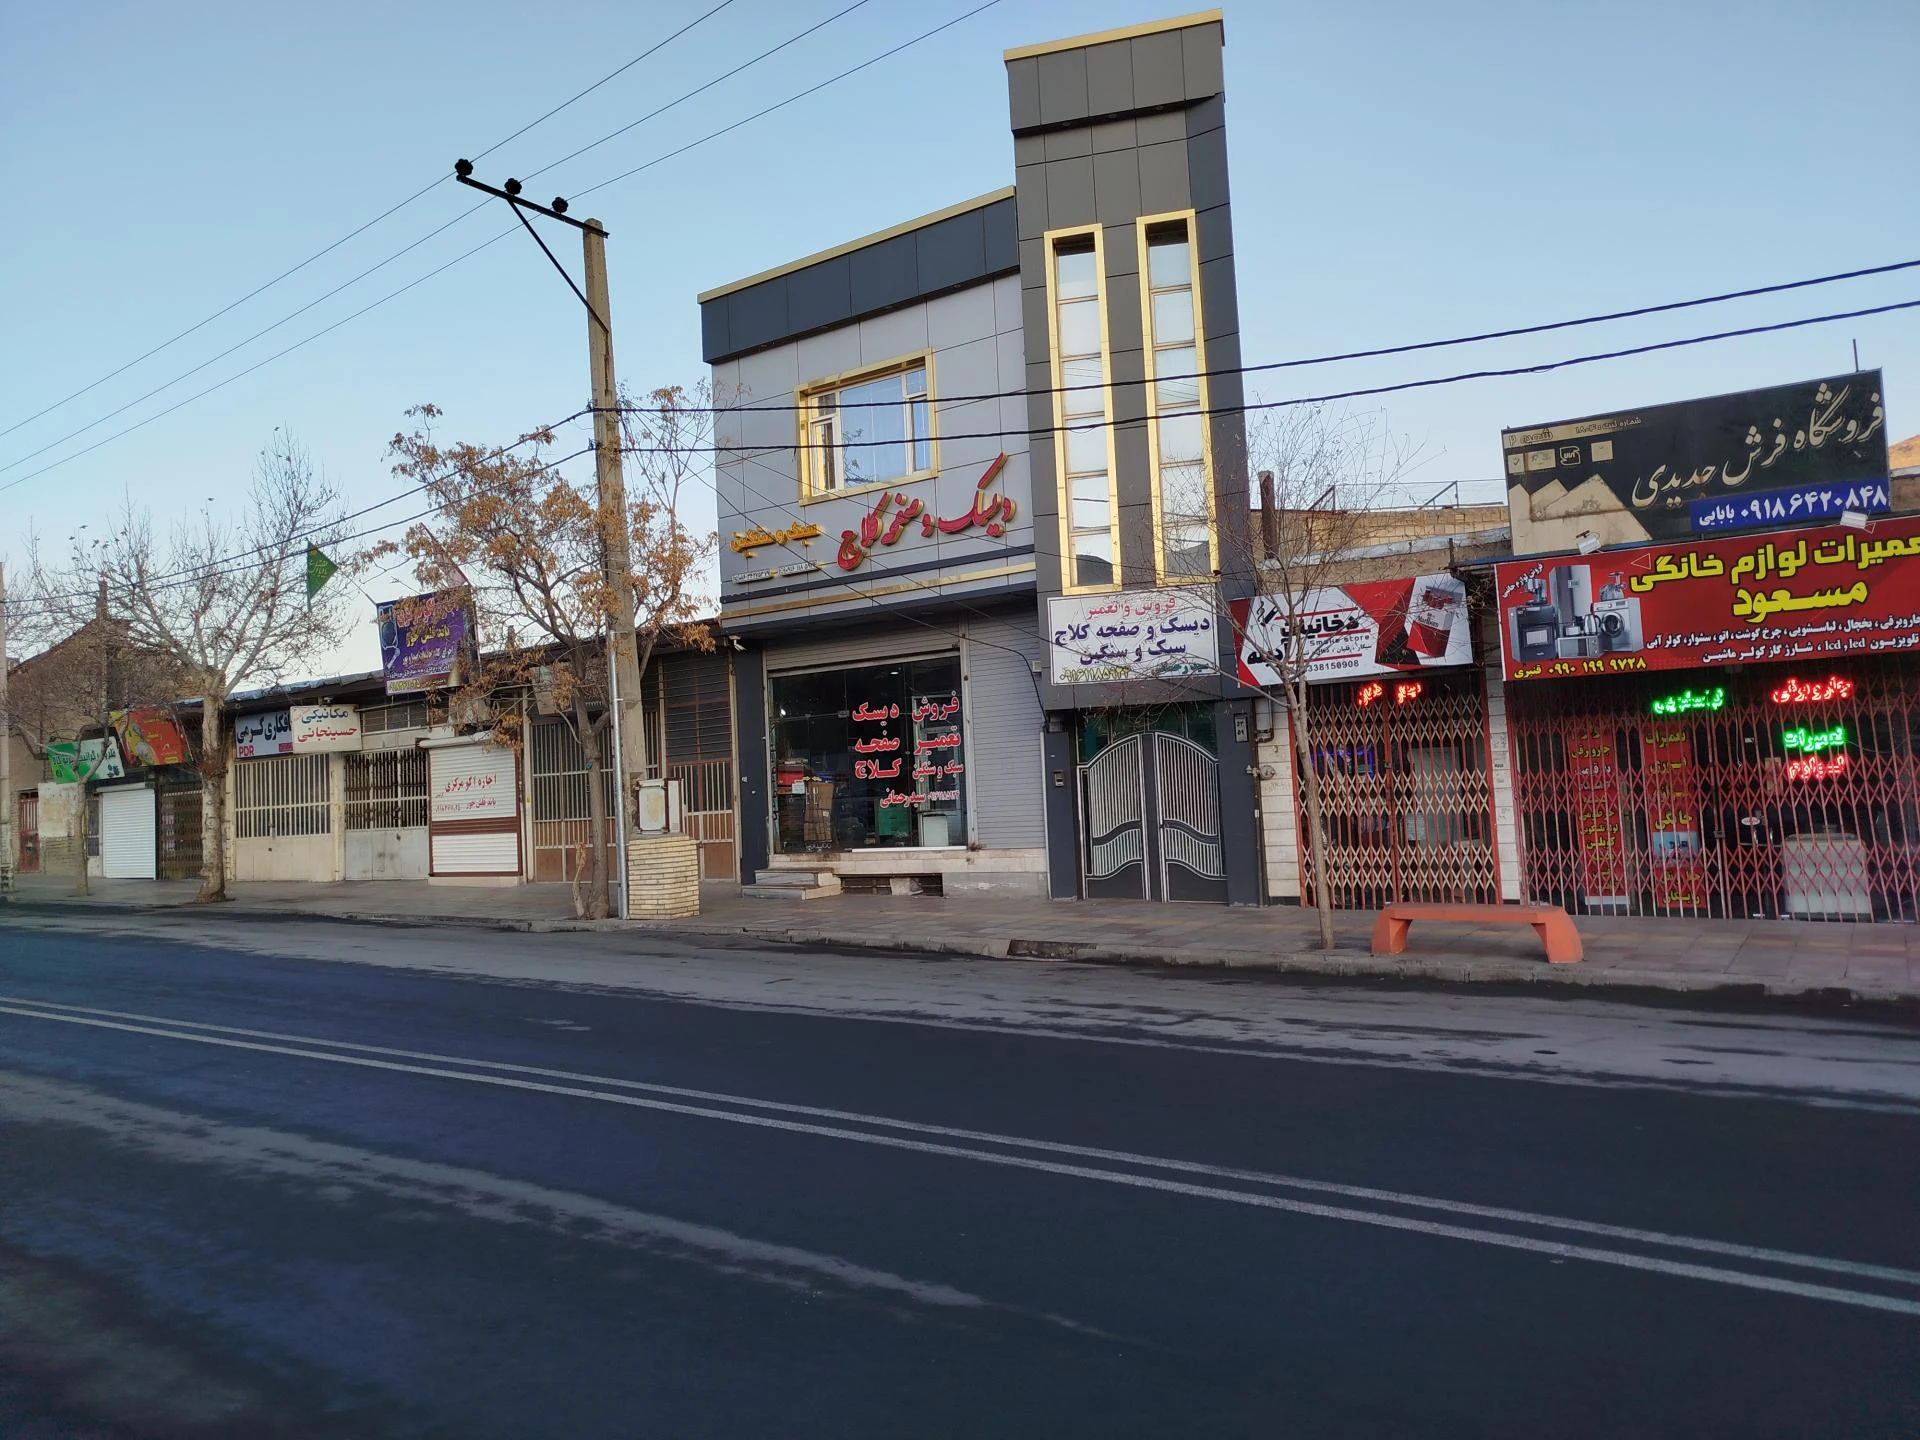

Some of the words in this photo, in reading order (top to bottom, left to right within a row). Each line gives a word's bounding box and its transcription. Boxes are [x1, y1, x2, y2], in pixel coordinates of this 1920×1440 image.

[1793, 382, 1884, 450] فروشگاه
[1722, 418, 1788, 486] فرش
[1699, 504, 1735, 526] بابایی
[921, 513, 935, 538] و
[1731, 540, 1807, 584] لوازم
[1629, 552, 1724, 593] خانگی
[1733, 580, 1868, 624] مسعود
[1055, 624, 1090, 646] کلاج
[1096, 622, 1140, 638] صفحه
[1147, 626, 1155, 641] و
[1160, 617, 1210, 636] دیسک
[1761, 627, 1782, 641] چرخ
[1148, 639, 1186, 655] سبک
[1664, 635, 1681, 649] کولر
[1784, 641, 1813, 657] شارژ
[1870, 633, 1919, 651] تلویزیون
[1134, 647, 1142, 662] و
[1702, 648, 1736, 663] ماشین
[1739, 646, 1765, 661] کولر
[852, 702, 900, 726] دیسک
[912, 690, 960, 721] فروش
[301, 708, 349, 725] مکانیکی
[854, 730, 900, 754] صفحه
[914, 726, 961, 755] تعمیر
[238, 745, 254, 757] PDR
[854, 758, 902, 779] کلاج
[912, 762, 936, 783] سنگین
[936, 766, 943, 782] و
[943, 760, 964, 778] سبک
